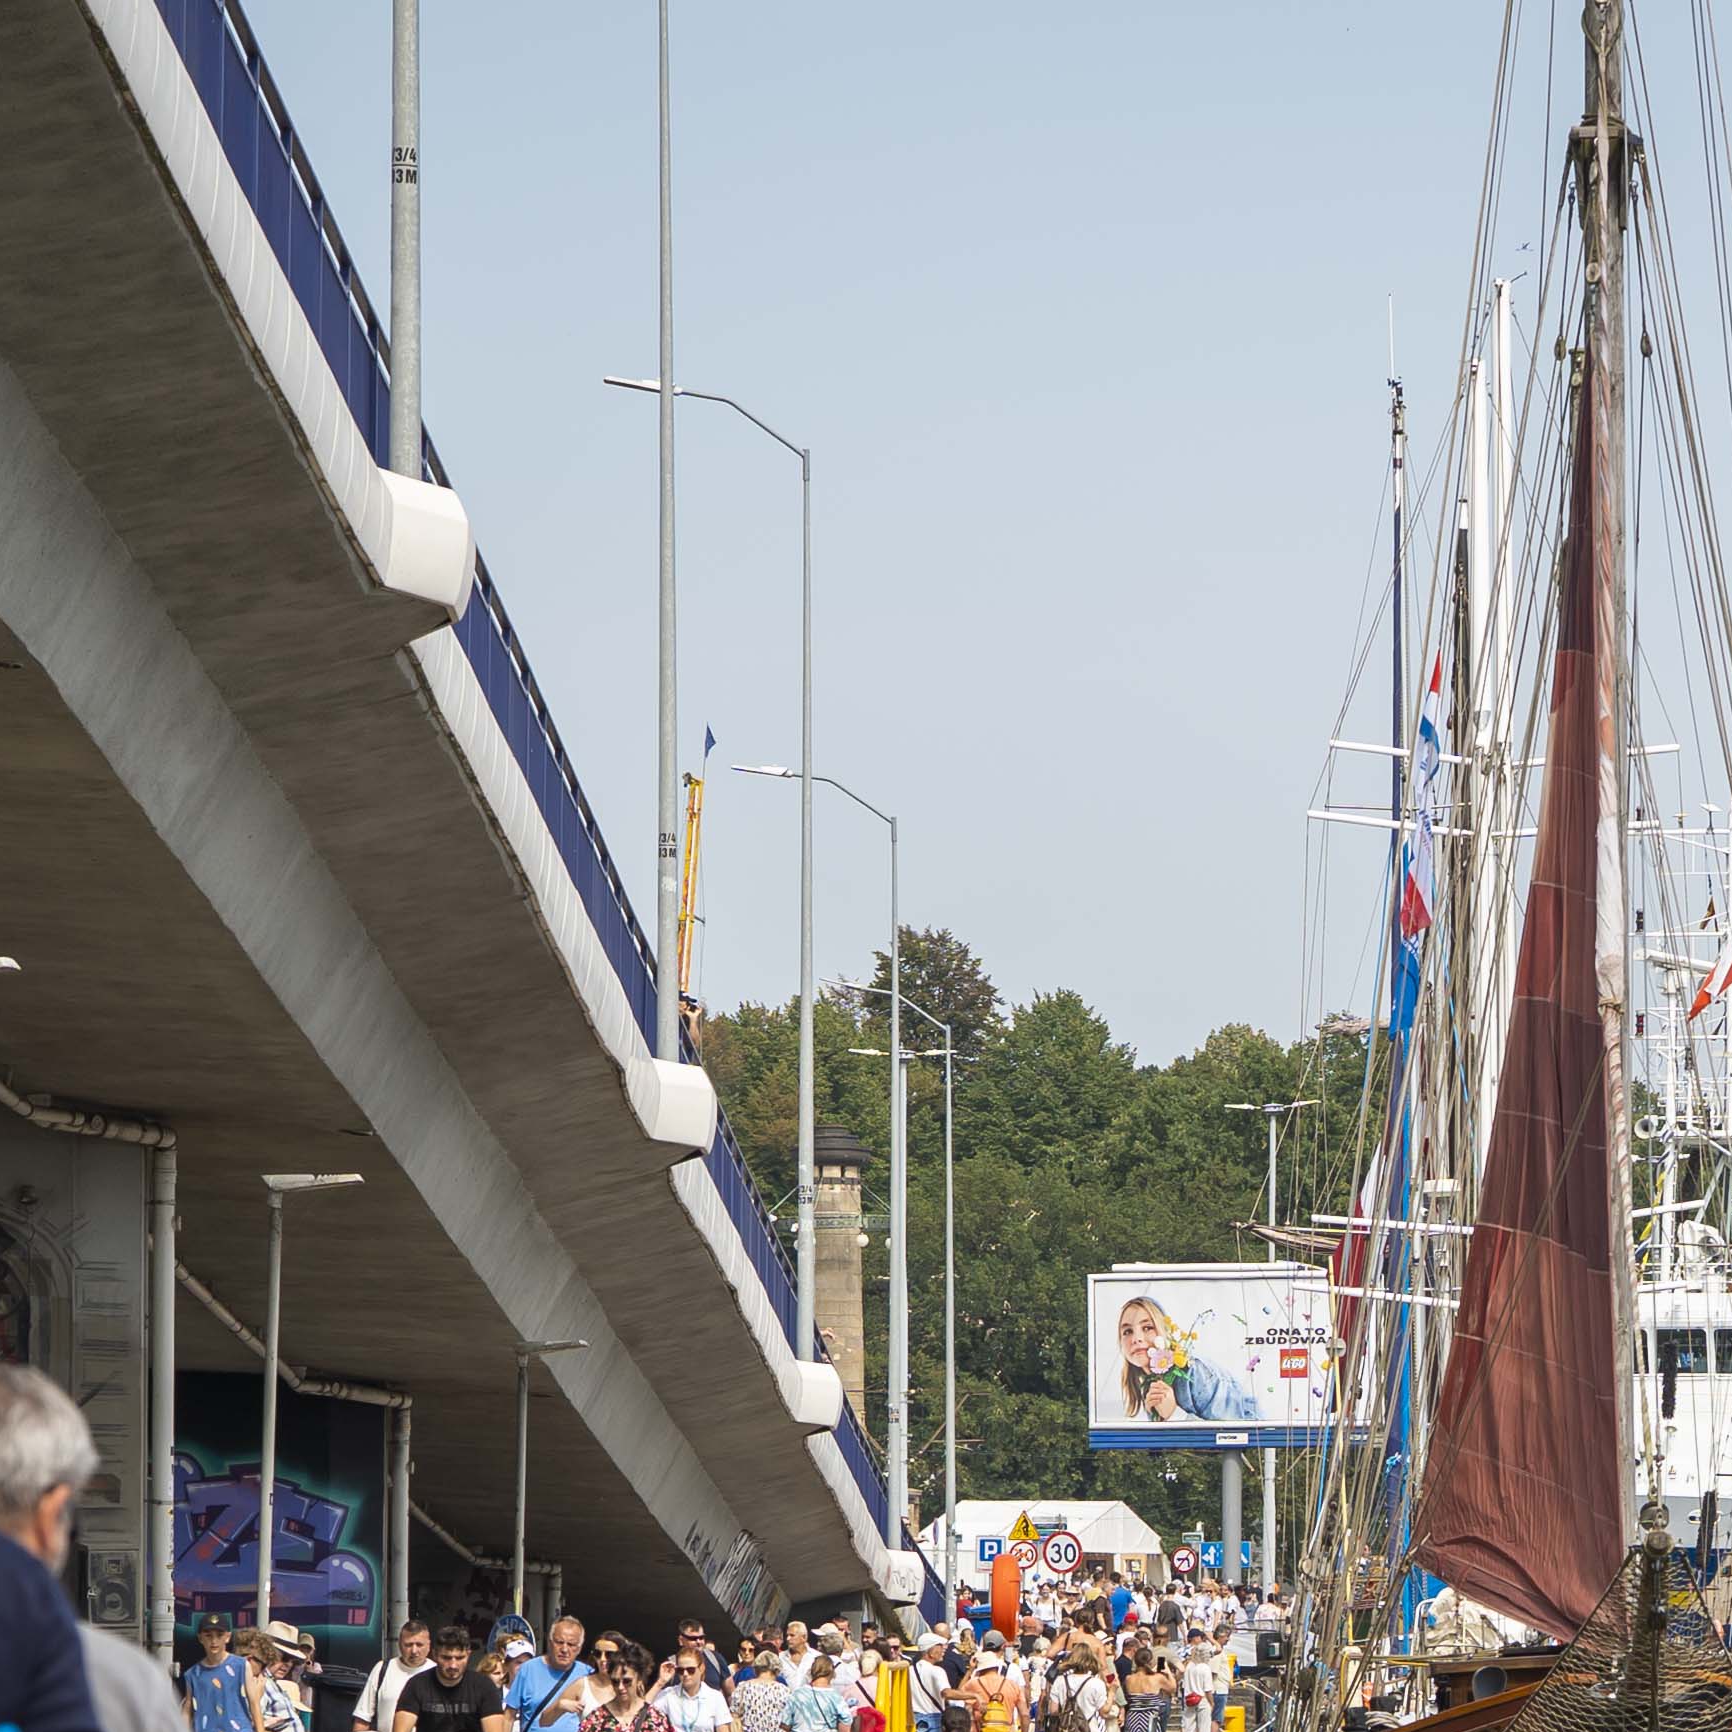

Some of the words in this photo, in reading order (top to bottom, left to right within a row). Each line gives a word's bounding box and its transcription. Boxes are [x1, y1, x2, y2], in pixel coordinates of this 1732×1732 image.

[1266, 1328, 1301, 1336] ONA
[1305, 1328, 1326, 1336] TO
[1245, 1337, 1333, 1345] ZBUDOWA
[1282, 1357, 1306, 1369] LEGO
[984, 1541, 998, 1559] P
[1050, 1543, 1077, 1564] 30
